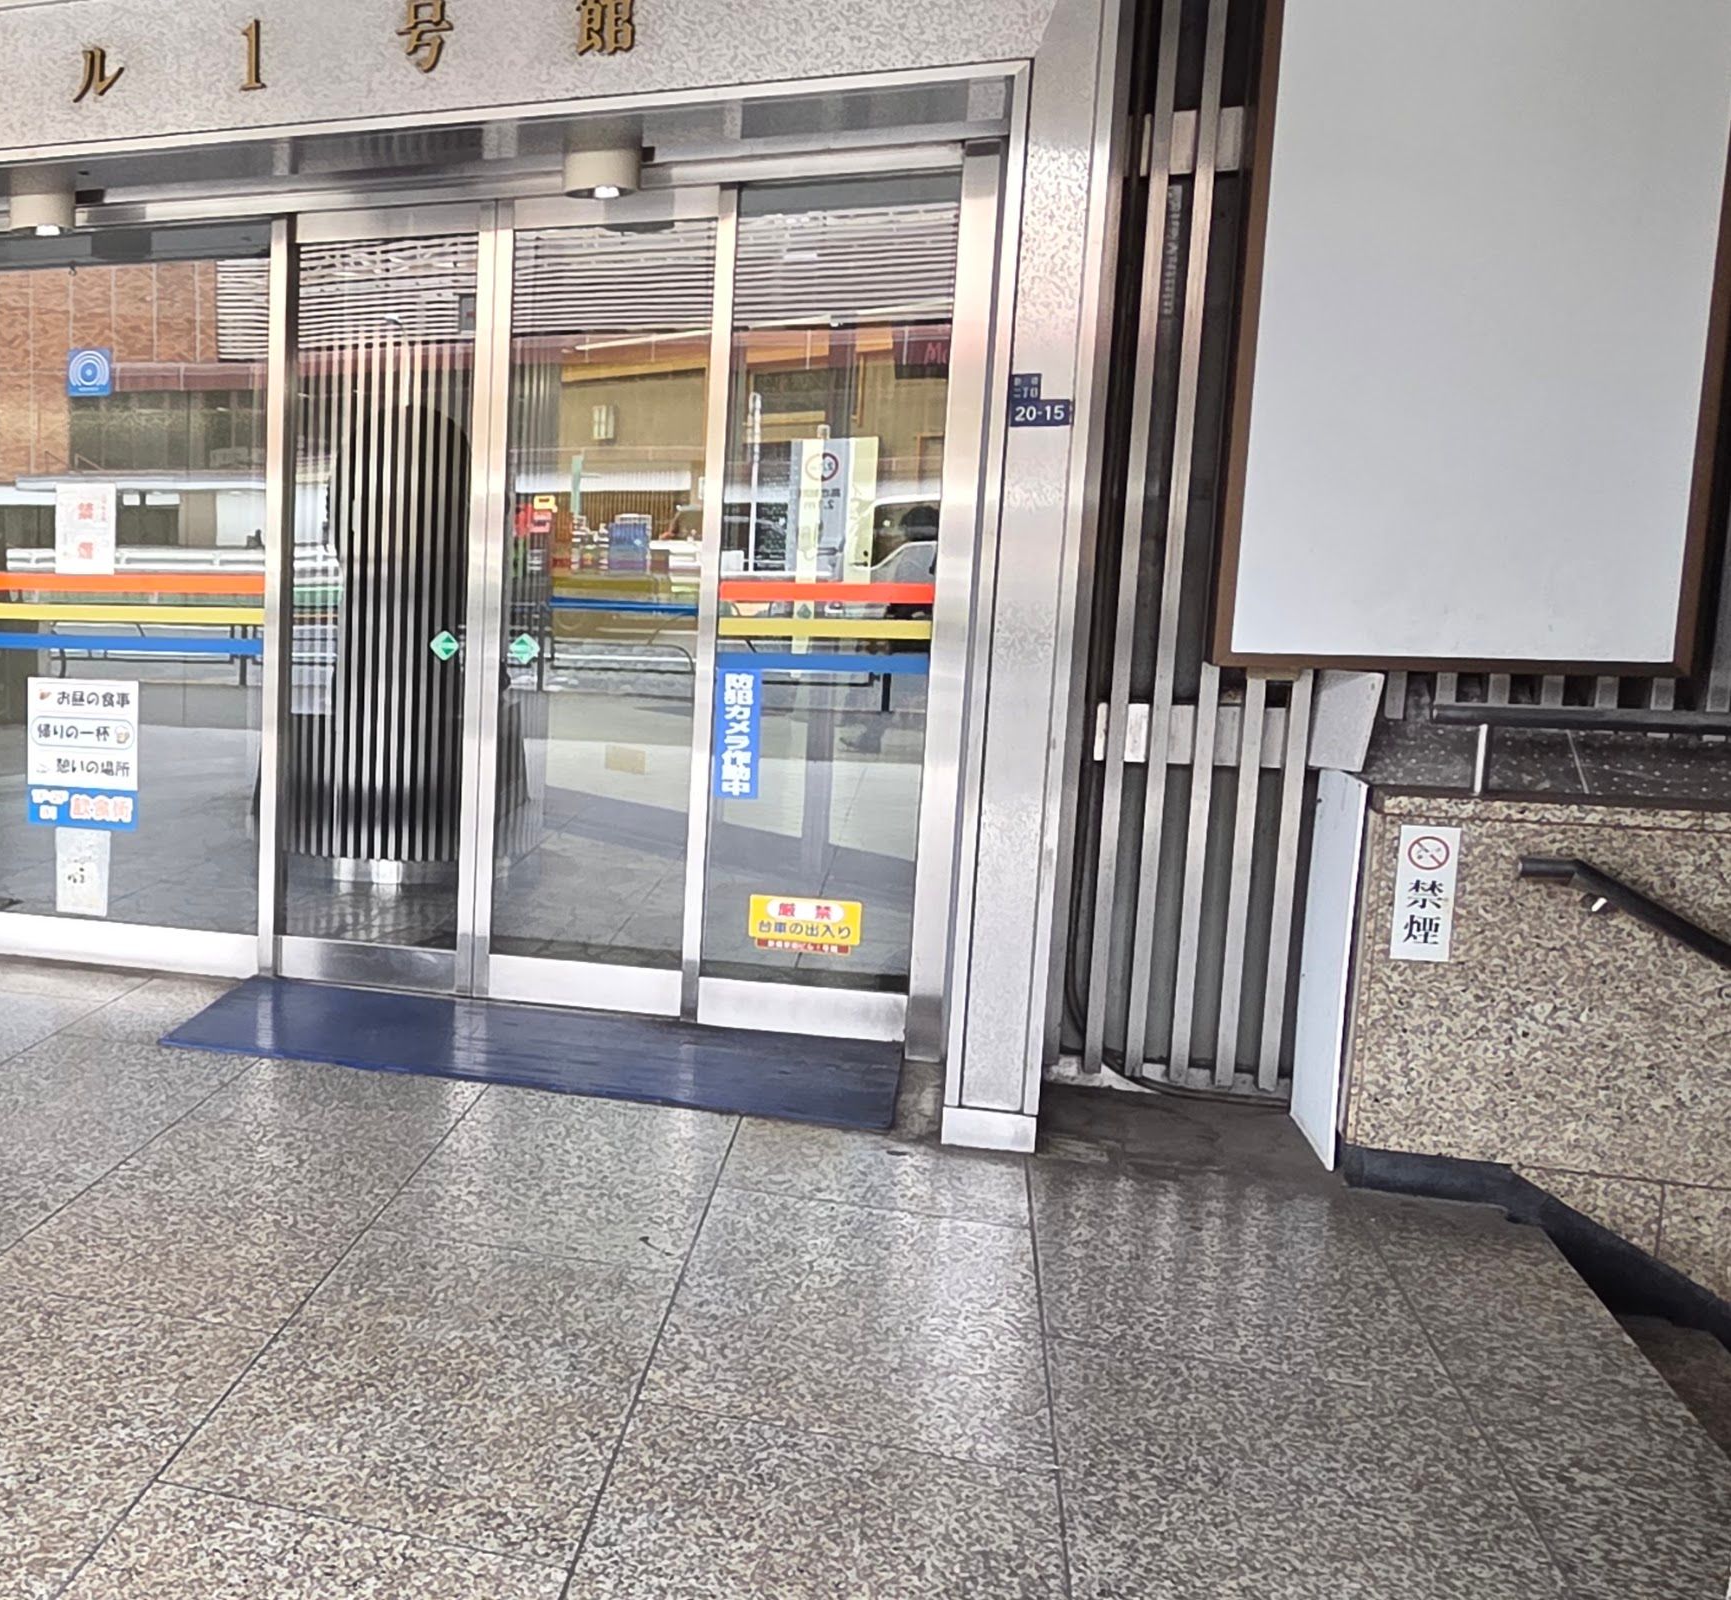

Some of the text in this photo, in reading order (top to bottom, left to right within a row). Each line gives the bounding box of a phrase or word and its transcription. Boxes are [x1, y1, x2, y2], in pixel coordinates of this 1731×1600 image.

[1014, 405, 1065, 422] 20-15
[56, 690, 131, 708] お昼の食事
[36, 723, 111, 742] 帰りの一杯
[721, 673, 755, 797] 防犯カメラ作動中
[56, 758, 130, 778] 憩いの場所
[1403, 879, 1445, 945] 禁煙
[758, 920, 851, 940] 台車の出入り
